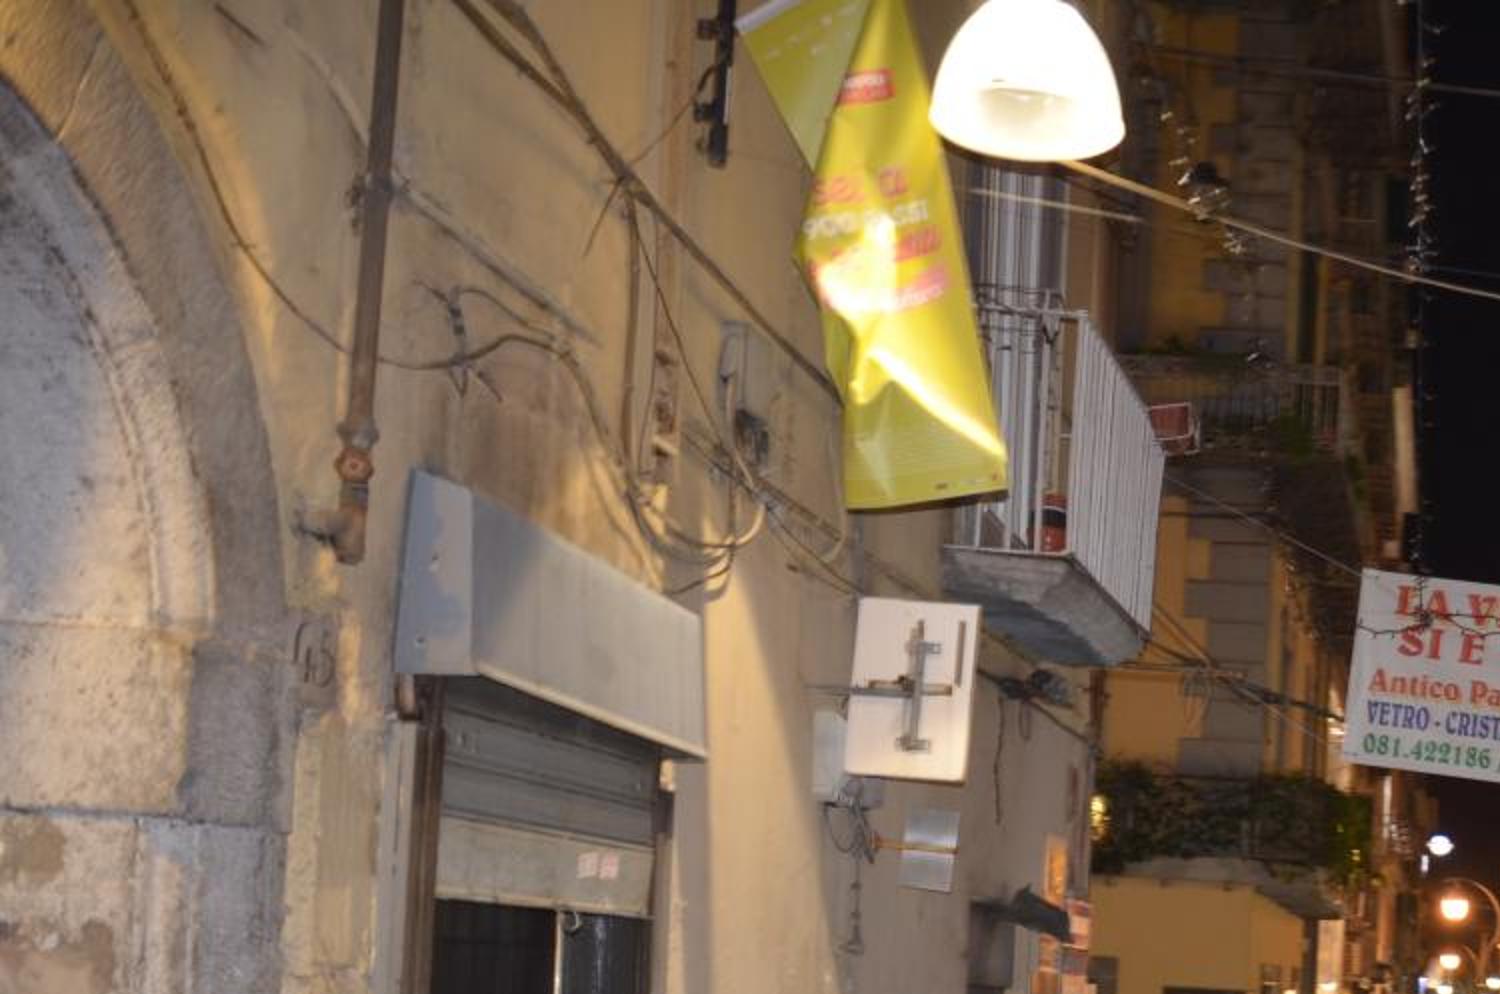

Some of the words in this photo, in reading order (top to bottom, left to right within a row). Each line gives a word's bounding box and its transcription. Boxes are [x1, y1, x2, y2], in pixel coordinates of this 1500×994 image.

[1395, 585, 1450, 620] LA
[1398, 626, 1444, 660] SI
[1367, 667, 1463, 703] Antico
[1366, 700, 1430, 732] VETRO
[1362, 732, 1492, 770] 081.422186
